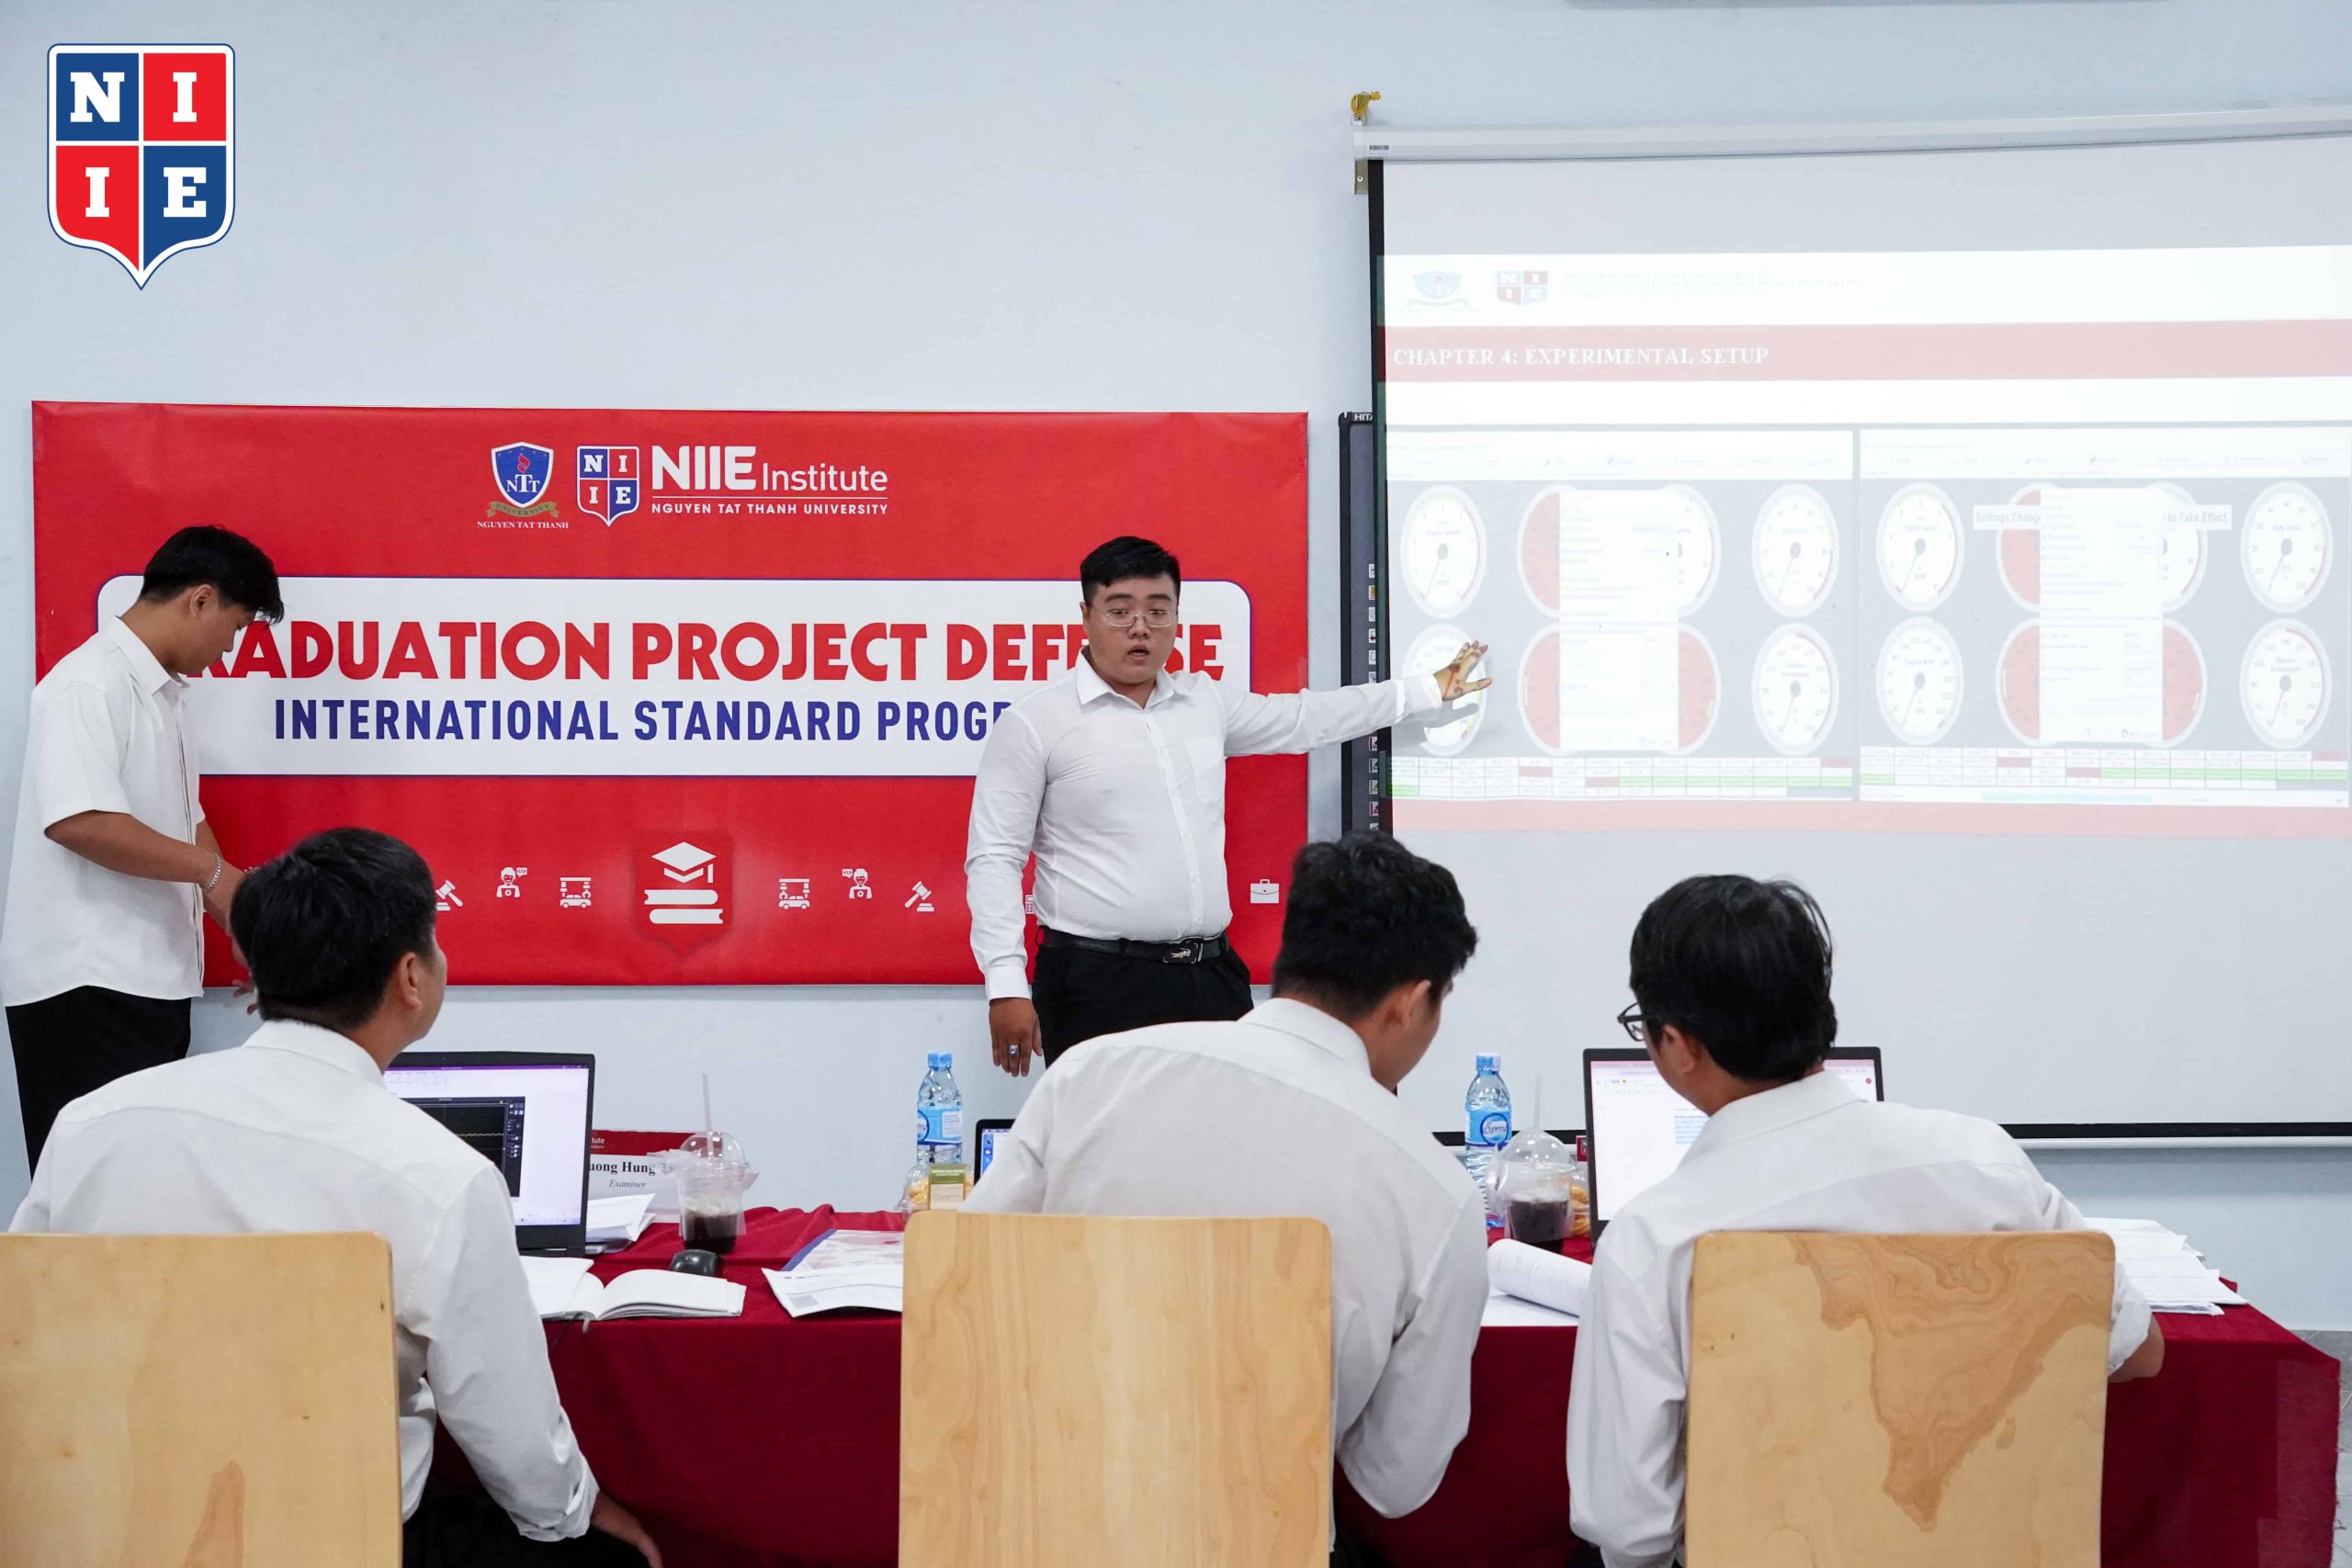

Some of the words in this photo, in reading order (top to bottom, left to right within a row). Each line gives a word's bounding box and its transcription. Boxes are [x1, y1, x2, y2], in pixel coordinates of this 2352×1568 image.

[1394, 348, 1494, 366] CHAPTER
[1501, 348, 1518, 365] 4:
[1526, 347, 1694, 365] EXPERIMENTAL
[1701, 346, 1770, 364] SETUP
[651, 446, 757, 491] NIIE
[763, 463, 888, 491] Institute
[506, 474, 540, 493] NTT
[495, 502, 550, 516] UNIVERSITY
[651, 503, 712, 514] NGUYEN
[718, 503, 741, 514] TAT
[747, 503, 797, 514] THANH
[804, 504, 888, 514] UNIVERSITY
[1975, 512, 2009, 525] Settings
[2179, 512, 2199, 523] Take
[477, 521, 515, 529] NGUYEN
[516, 521, 537, 529] TAT
[537, 521, 569, 529] THANH
[187, 620, 609, 681] ADUATION
[633, 622, 928, 682] PROJECT
[276, 699, 619, 740] INTERNATIONAL
[634, 701, 861, 741] STANDARD
[877, 701, 1012, 741] PROG
[589, 1162, 618, 1175] uong
[622, 1161, 656, 1176] Hung
[609, 1179, 647, 1188] Examiner
